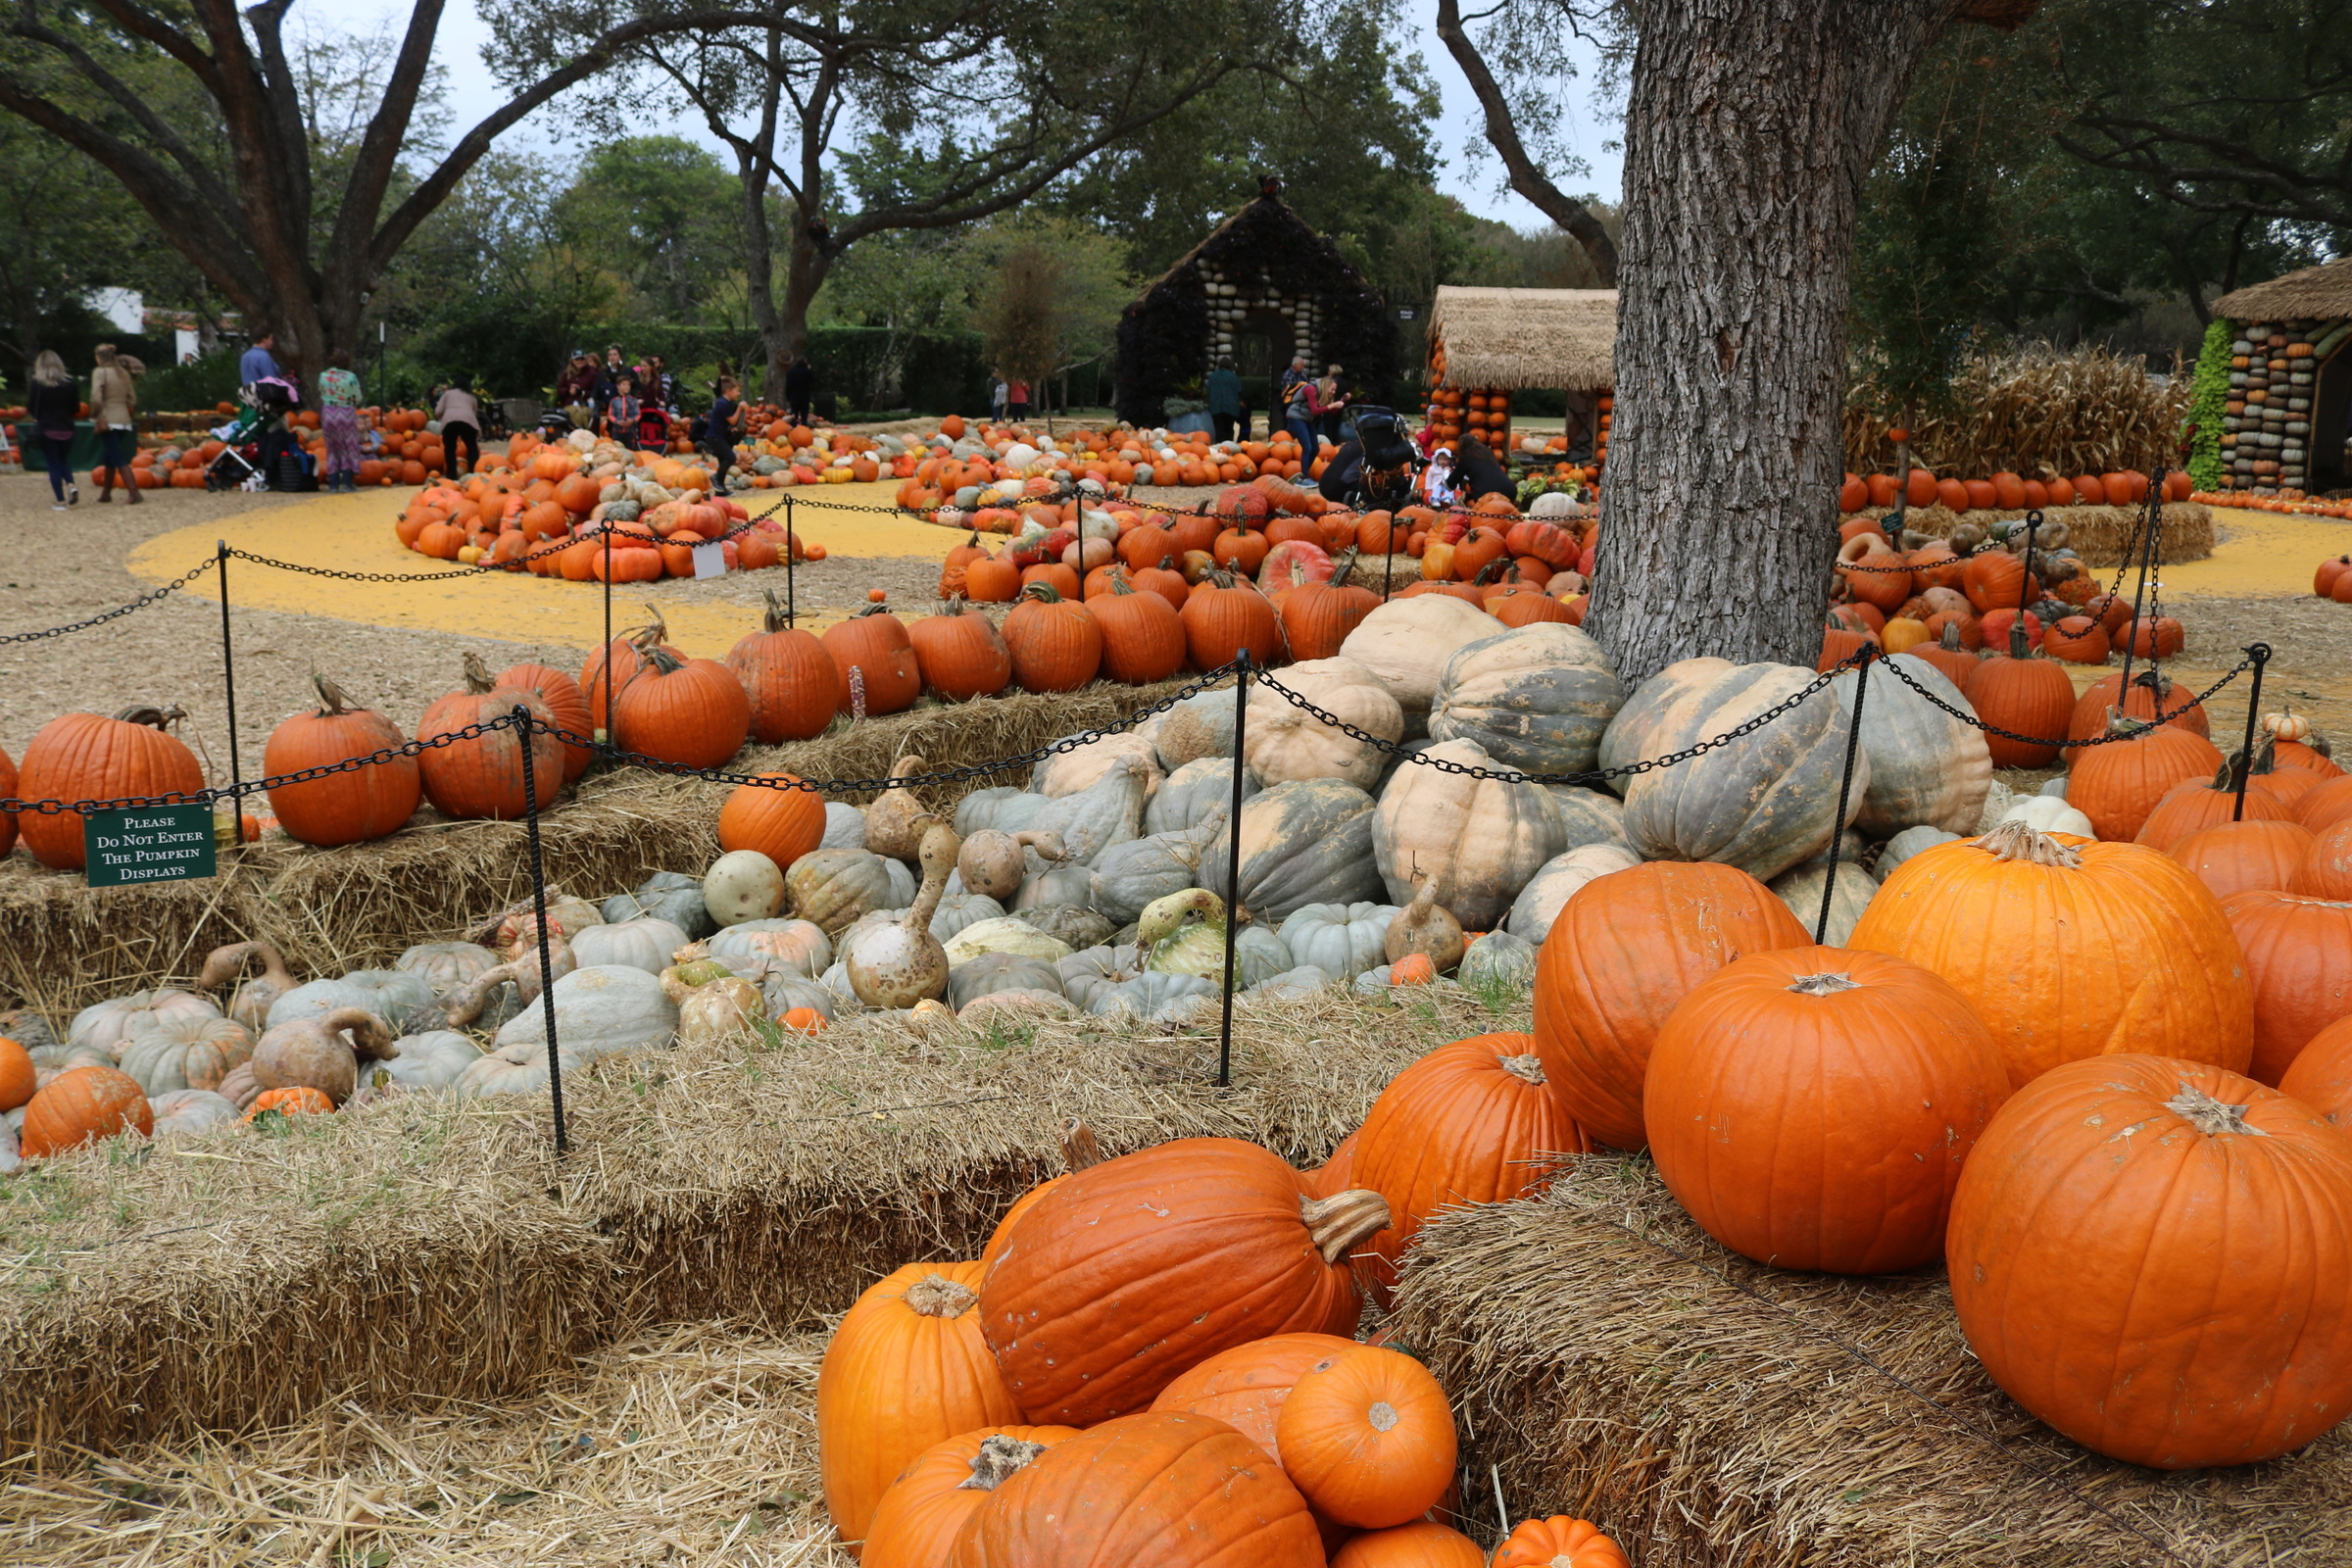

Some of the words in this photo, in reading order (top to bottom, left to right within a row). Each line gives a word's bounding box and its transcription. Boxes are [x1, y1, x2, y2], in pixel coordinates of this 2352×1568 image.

[124, 817, 175, 829] PLEASE
[96, 837, 120, 849] DO
[122, 834, 154, 847] NOT
[157, 831, 204, 844] ENTER
[101, 853, 132, 865] THE
[135, 849, 201, 862] PUMPKIN
[120, 866, 186, 880] DISPLAYS
